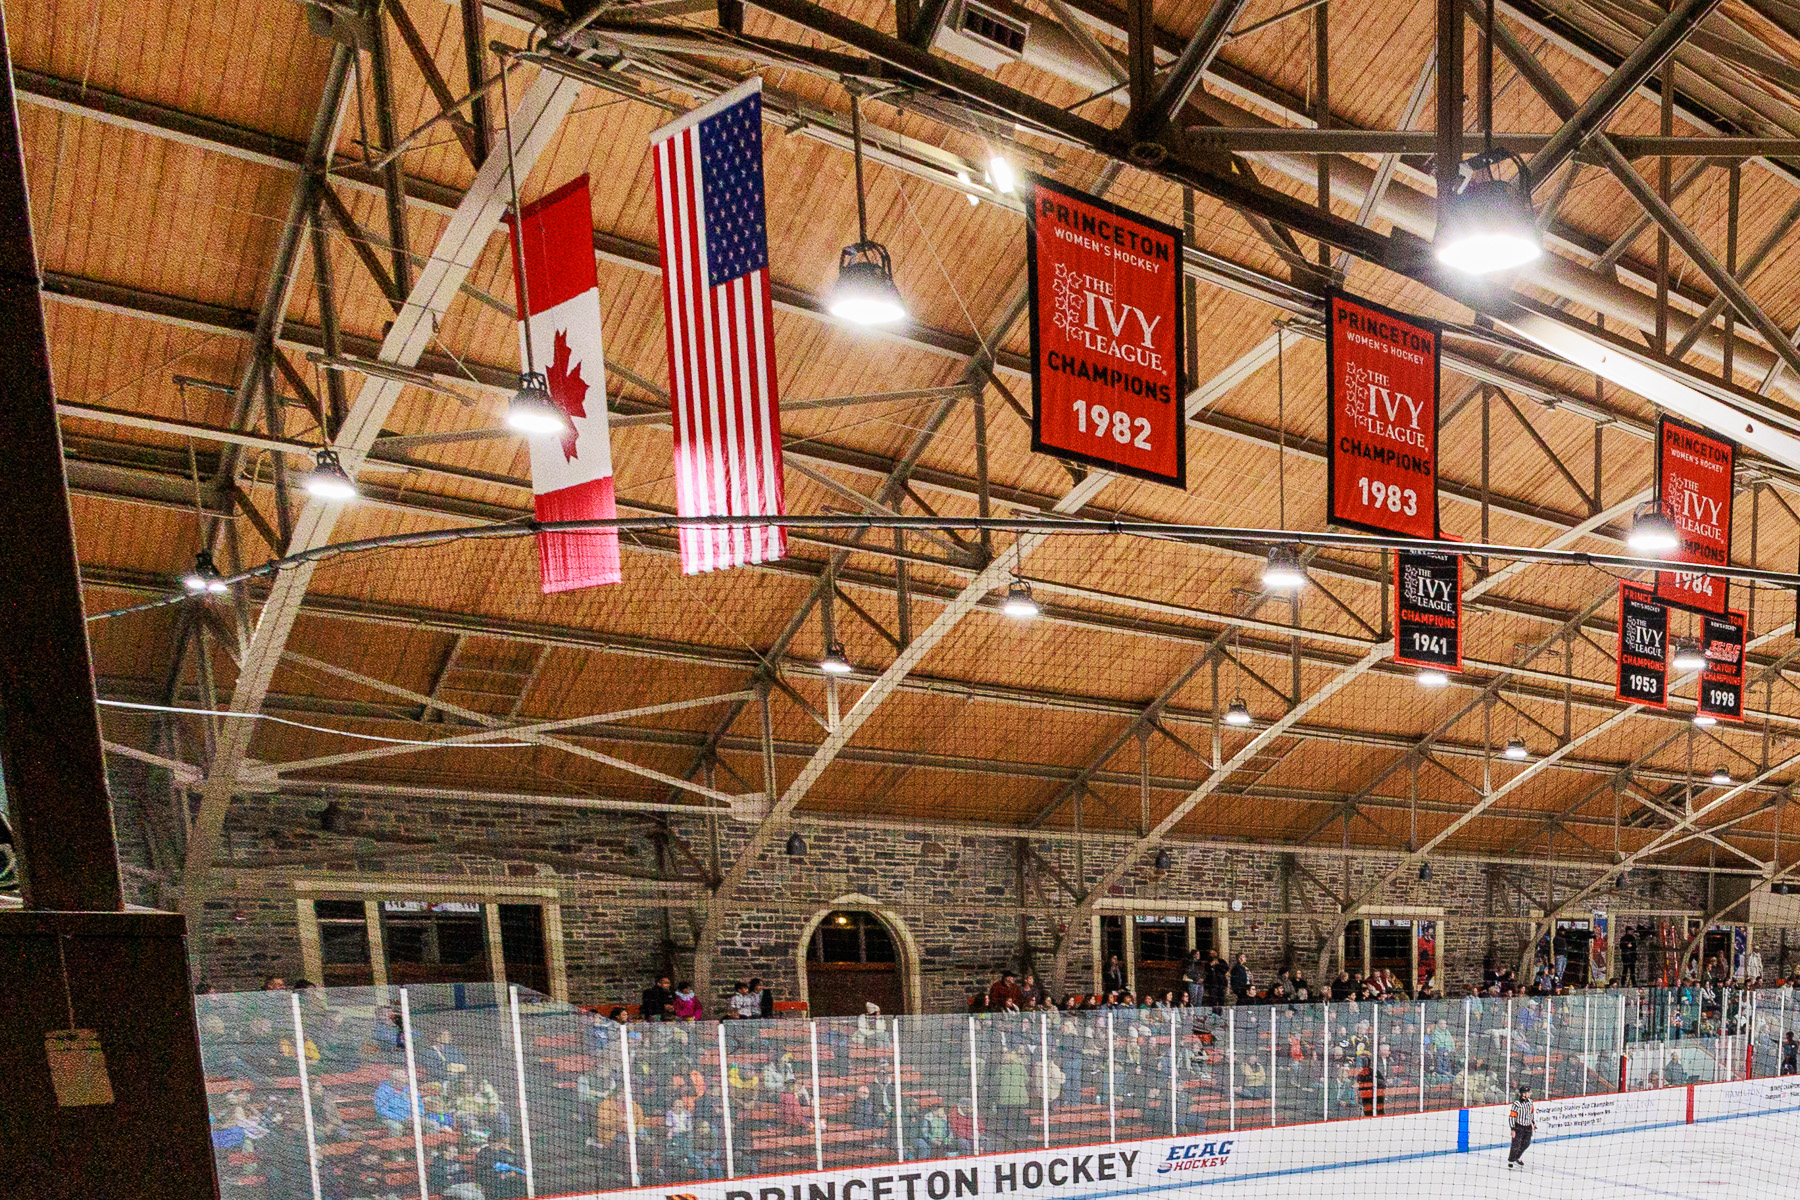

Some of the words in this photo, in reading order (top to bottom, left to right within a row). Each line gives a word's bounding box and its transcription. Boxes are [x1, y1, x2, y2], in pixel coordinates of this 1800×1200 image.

[1041, 199, 1169, 262] PRINCETON
[1053, 226, 1111, 257] WOMEN'S
[1114, 248, 1160, 274] HOCKEY
[1082, 274, 1114, 296] THE
[1083, 290, 1161, 349] IVY
[1338, 308, 1431, 355] PRINCETON
[1084, 330, 1163, 371] LEAGUE
[1346, 331, 1388, 355] WOMEN'S
[1390, 346, 1425, 366] HOCKEY
[1047, 350, 1171, 404] CHAMPIONS
[1367, 369, 1390, 387] THE
[1367, 384, 1424, 430] IVY
[1072, 399, 1152, 451] 1982
[1368, 417, 1426, 449] LEAGUE
[1340, 437, 1431, 477] CHAMPIONS
[1665, 429, 1729, 463] PRINCETON
[1670, 448, 1698, 465] WOMEN'S
[1700, 457, 1724, 474] HOCKEY
[1358, 476, 1417, 517] 1983
[1683, 478, 1699, 492] THE
[1682, 490, 1723, 526] IVY
[1682, 518, 1722, 541] LEAGUE
[1418, 568, 1431, 577] THE
[1417, 576, 1452, 601] IVY
[1417, 597, 1453, 612] LEAGUE
[1401, 609, 1456, 629] CHAMPIONS
[1636, 619, 1647, 627] THE
[1413, 632, 1447, 655] 1941
[1635, 626, 1663, 647] IVY
[1622, 654, 1665, 672] CHAMPIONS
[1630, 674, 1657, 694] 1953
[1710, 689, 1735, 707] 1998
[1165, 1140, 1234, 1161] ECAC
[994, 1150, 1140, 1193] HOCKEY
[1173, 1156, 1229, 1172] HOCKEY
